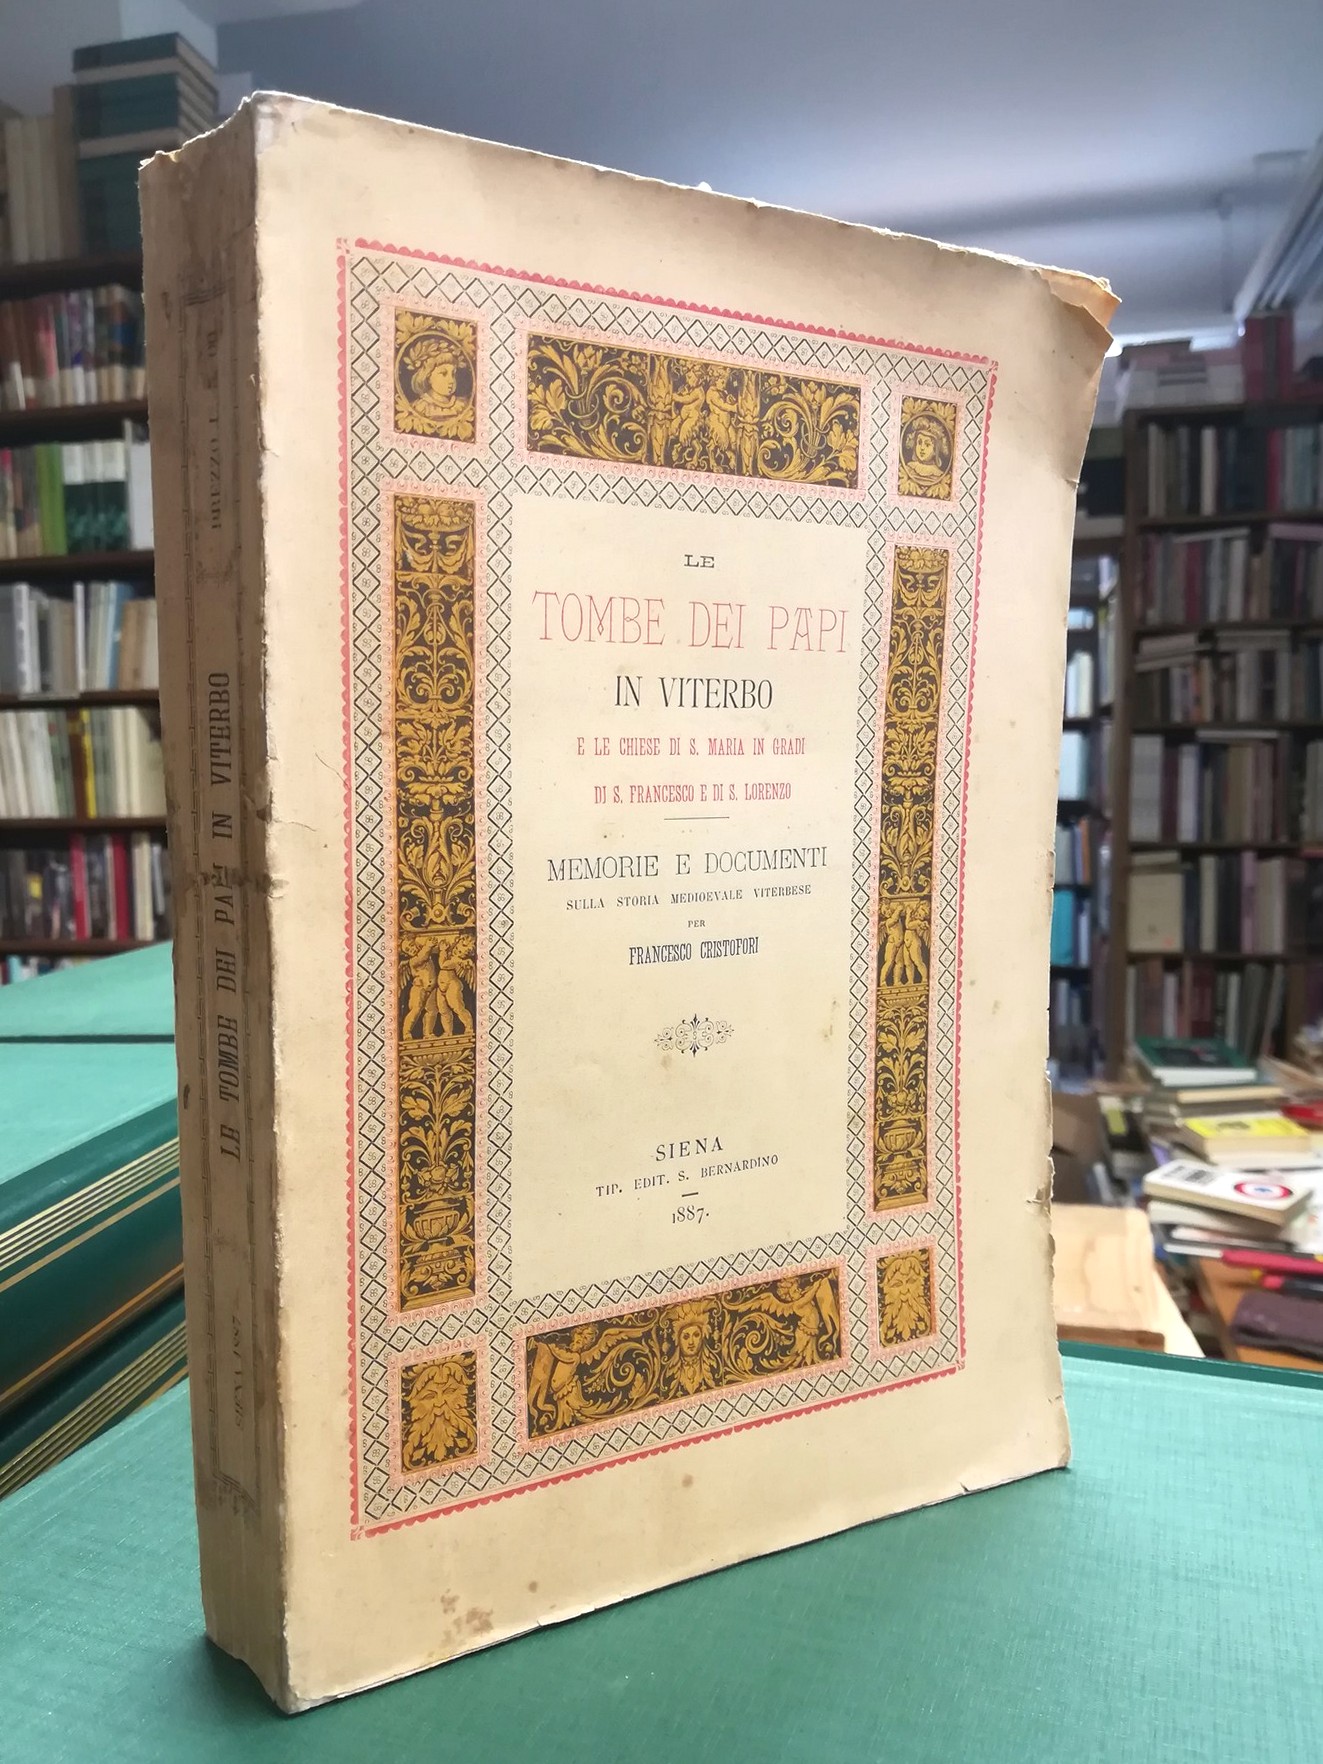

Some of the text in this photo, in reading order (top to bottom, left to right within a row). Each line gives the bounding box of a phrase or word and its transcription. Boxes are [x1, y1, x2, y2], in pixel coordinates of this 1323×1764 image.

[683, 554, 715, 568] LE
[532, 590, 849, 653] TOMBE DEI PAPI
[614, 675, 773, 709] IN VITERBO
[208, 672, 232, 787] VITERBO
[576, 736, 806, 756] E LE CHIESE DI S. MARIA IN GRADI
[613, 785, 623, 804] S.
[629, 785, 695, 804] FRANCESCO
[700, 784, 708, 802] E
[712, 783, 724, 802] DI
[729, 783, 738, 801] S.
[744, 782, 792, 801] LORENZO
[211, 810, 233, 840] IN
[547, 846, 828, 882] MEMORIE E DOCUMENTI
[566, 884, 812, 911] SULLA STORIA MEDIOEVALE VITERBESE
[687, 919, 706, 929] PER
[629, 936, 759, 965] FRANCESCO CRISTOFORI
[215, 947, 237, 994] DEI
[217, 1014, 240, 1103] TOMBE
[219, 1123, 241, 1162] LE
[655, 1136, 723, 1162] SIENA
[595, 1154, 779, 1197] TIP. EDIT. S. BERNARDINO
[672, 1205, 710, 1224] 1887.
